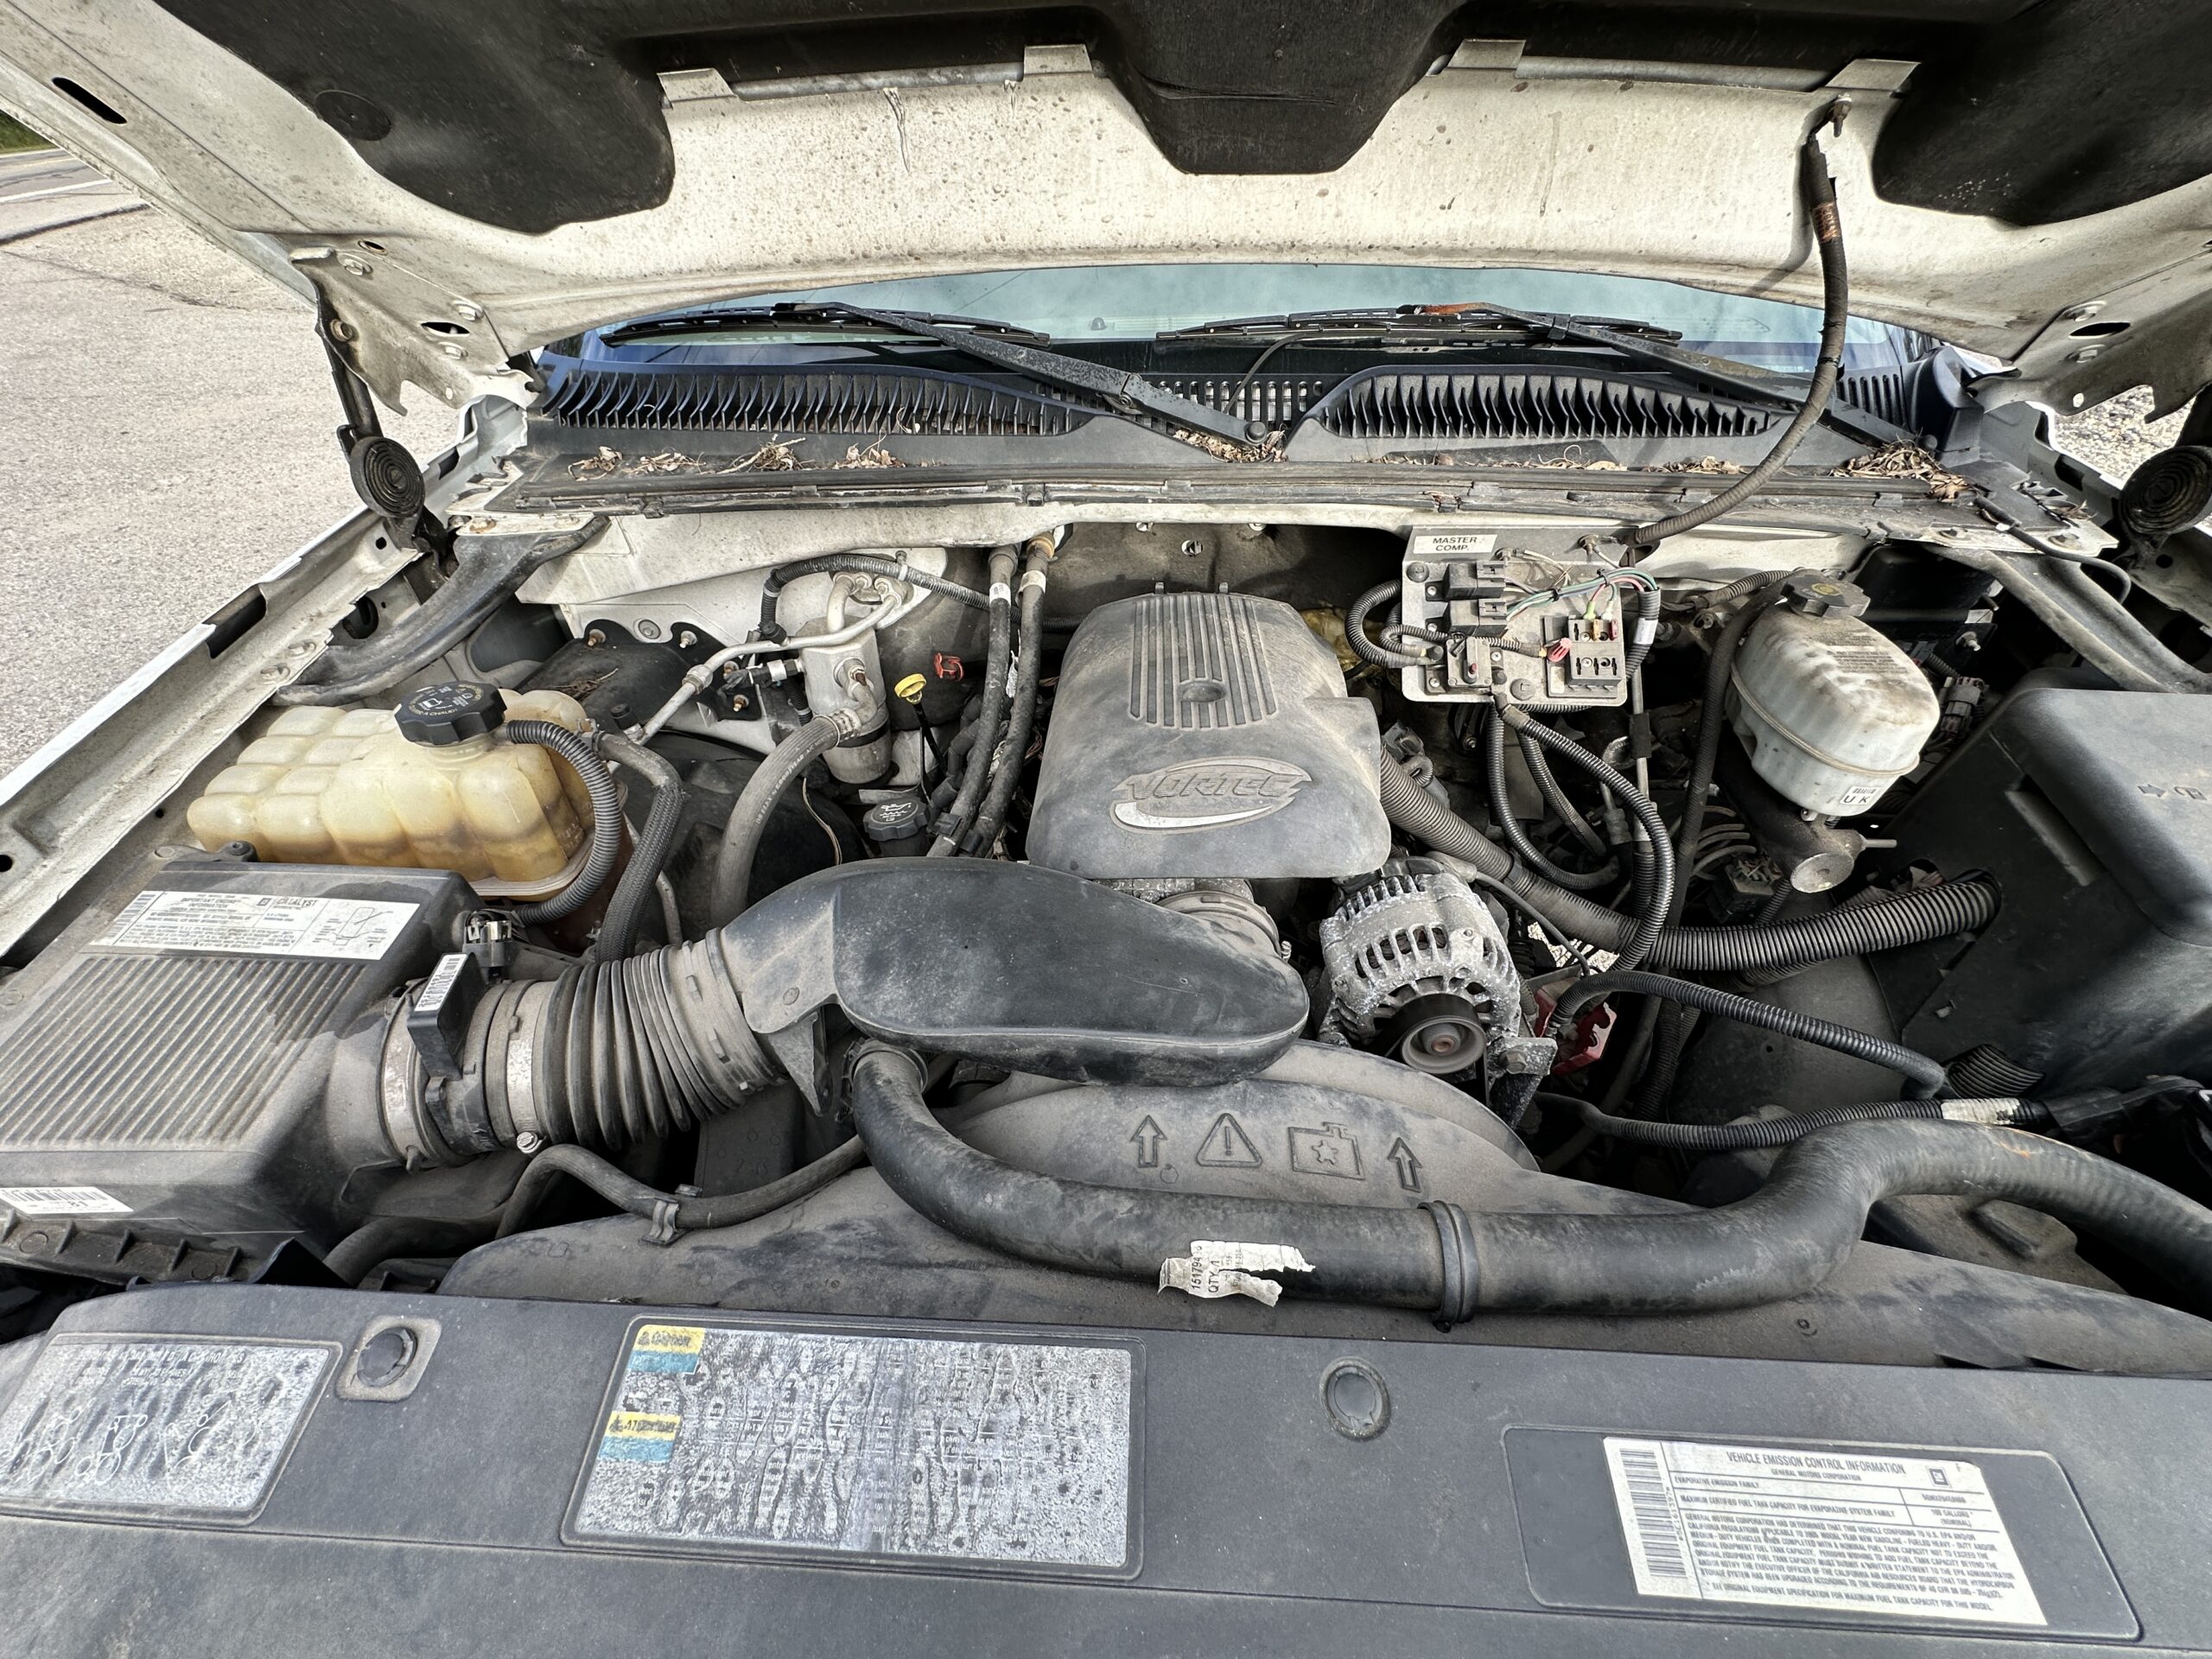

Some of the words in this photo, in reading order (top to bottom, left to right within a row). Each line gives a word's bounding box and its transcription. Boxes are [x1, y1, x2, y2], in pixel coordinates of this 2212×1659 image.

[276, 897, 318, 907] CATALYST
[1208, 1270, 1219, 1293] QTY
[1726, 1451, 1761, 1464] VEHICLE
[1762, 1453, 1803, 1466] EMISSION
[1803, 1457, 1845, 1469] CONTROL
[1845, 1459, 1906, 1473] INFORMATION
[1708, 1497, 1737, 1505] CERTIFIED
[1769, 1501, 1796, 1510] CAPACITY
